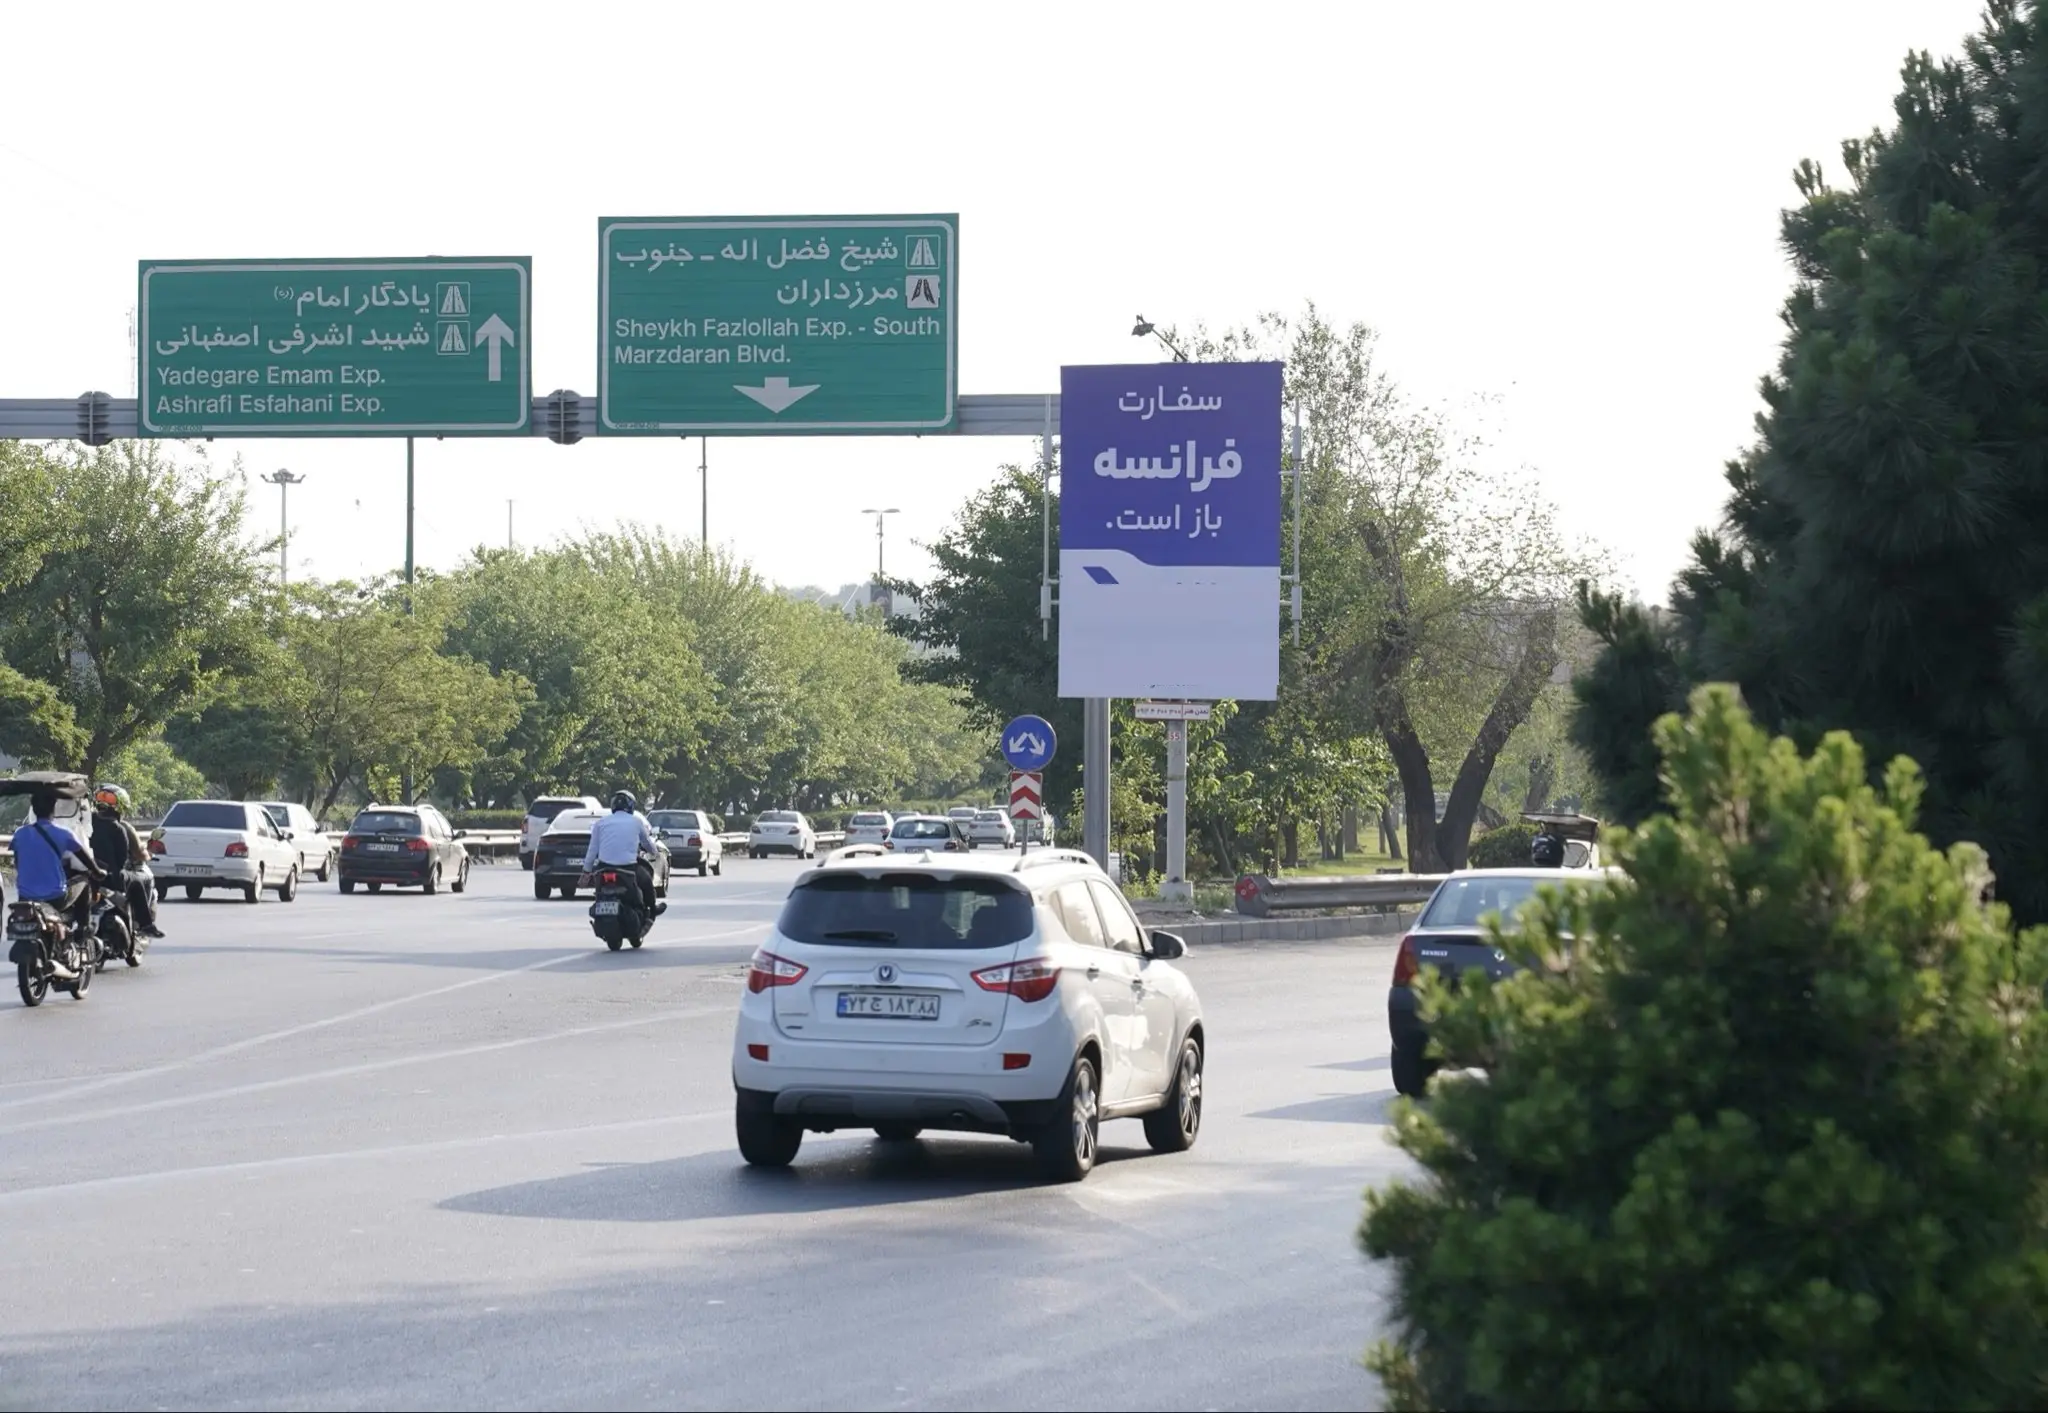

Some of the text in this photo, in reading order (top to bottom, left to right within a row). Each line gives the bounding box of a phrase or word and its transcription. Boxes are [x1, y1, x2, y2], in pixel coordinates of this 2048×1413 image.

[616, 243, 694, 272] جنوب
[720, 238, 758, 261] اله
[766, 236, 831, 269] فضل
[840, 236, 899, 271] شیخ
[296, 285, 350, 316] امام
[355, 281, 431, 315] یادگار
[776, 278, 899, 309] مرزداران
[156, 321, 430, 355] شهید اشرفی اصفهانی
[615, 318, 696, 341] Sheykh
[703, 318, 799, 338] Fazlollah
[806, 318, 853, 340] Exp.
[873, 316, 940, 336] South
[614, 344, 791, 365] Marzdaran Blvd.
[156, 366, 386, 387] Yadegare Emam Exp.
[156, 393, 386, 416] Ashrafi Esfahani Exp.
[1118, 385, 1222, 420] سفارت
[1093, 438, 1243, 492] فرانسه
[1105, 504, 1223, 538] باز است.
